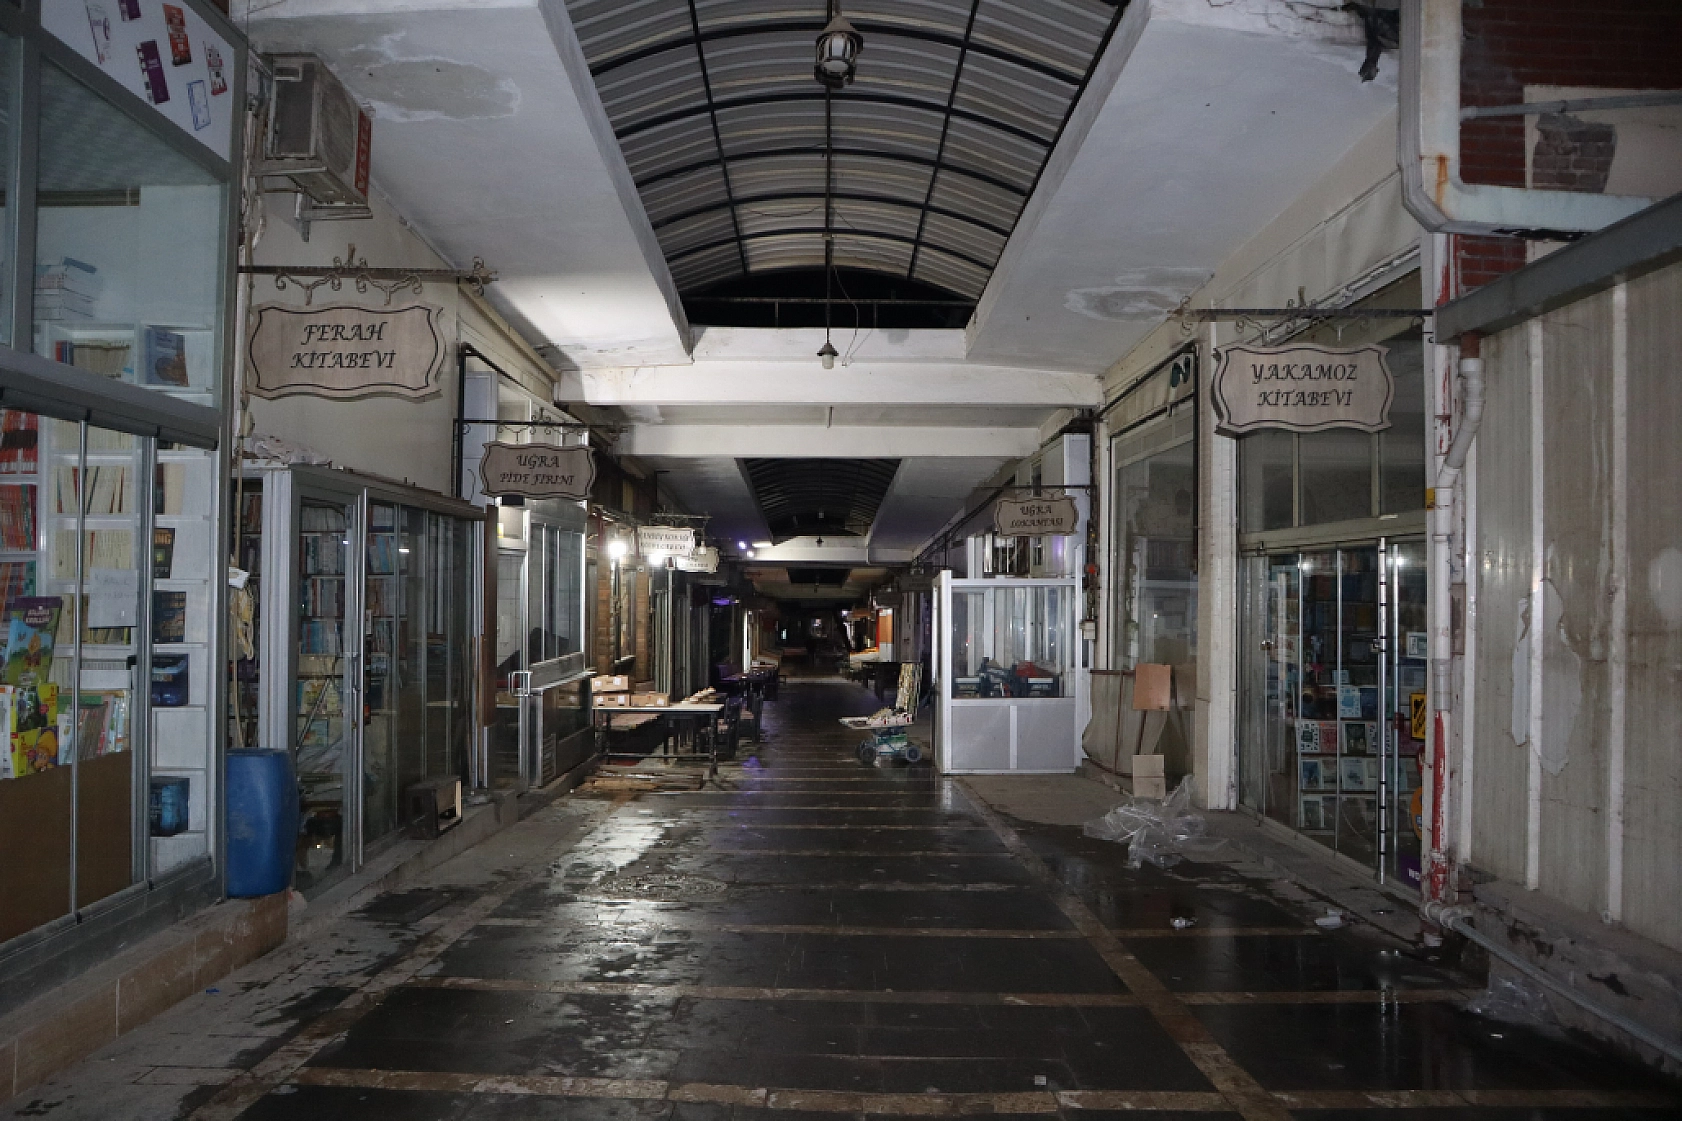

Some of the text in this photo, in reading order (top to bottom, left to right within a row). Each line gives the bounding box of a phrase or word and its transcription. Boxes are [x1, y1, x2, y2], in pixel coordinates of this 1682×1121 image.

[301, 322, 387, 344] FERAH
[291, 350, 397, 369] KİTABEVİ
[1252, 363, 1357, 385] YAKAMOZ
[1257, 389, 1353, 408] KİTABEVİ
